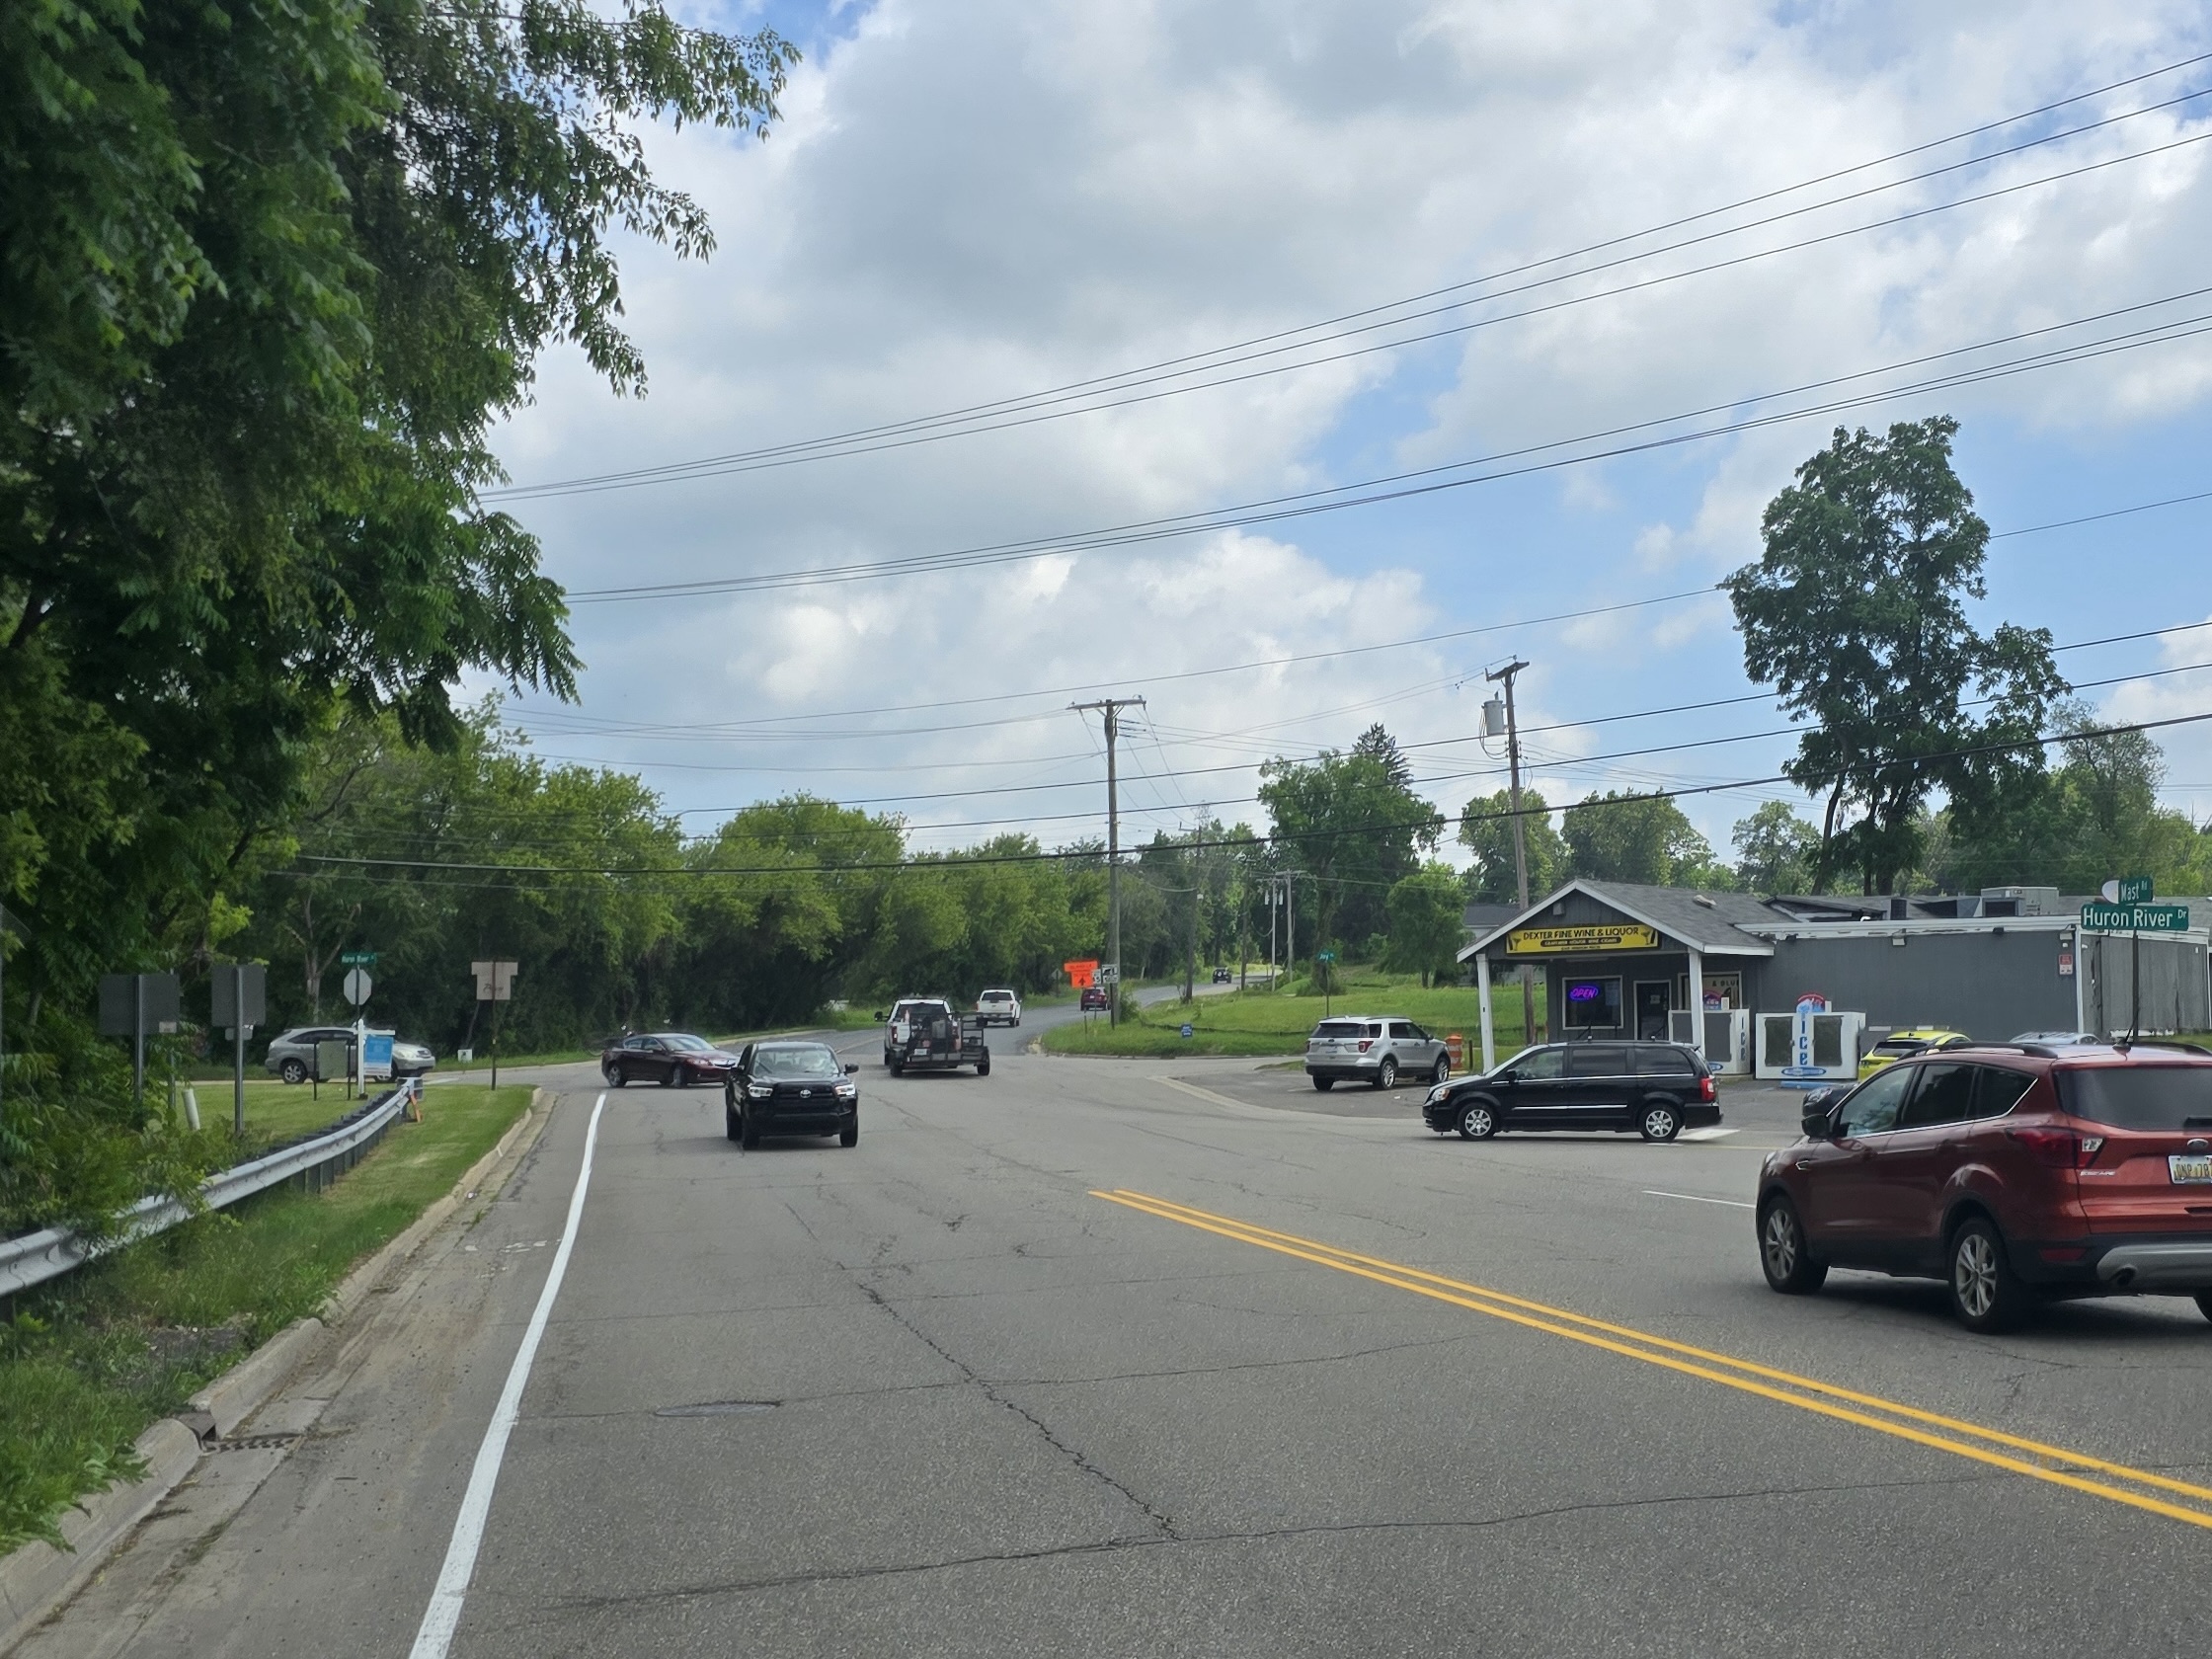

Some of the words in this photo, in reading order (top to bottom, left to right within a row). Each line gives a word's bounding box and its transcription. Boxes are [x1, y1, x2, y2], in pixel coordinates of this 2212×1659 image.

[2121, 883, 2139, 902] Mast
[2142, 881, 2148, 891] Rd
[2083, 908, 2129, 926] Huron
[2133, 908, 2172, 927] River
[2177, 909, 2186, 919] Dr
[1523, 930, 1553, 940] DEXTER
[1554, 929, 1573, 939] FINE
[1574, 928, 1596, 938] WINE
[1605, 926, 1639, 937] LIQUOR
[1572, 988, 1596, 998] OPEN
[1799, 1020, 1808, 1066] Ice
